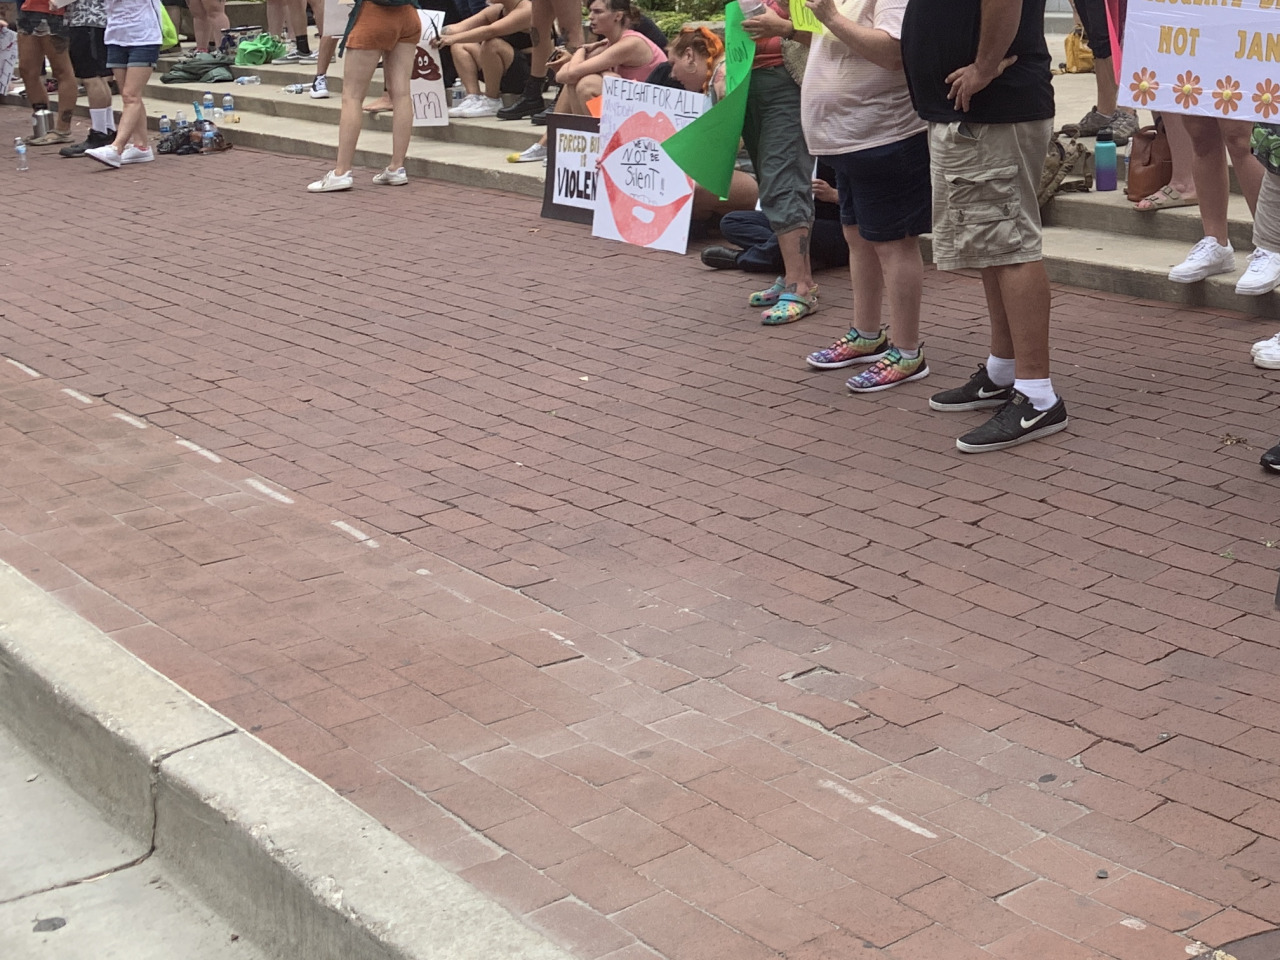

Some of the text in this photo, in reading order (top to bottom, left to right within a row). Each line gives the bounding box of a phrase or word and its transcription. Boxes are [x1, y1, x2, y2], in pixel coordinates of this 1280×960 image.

[1158, 24, 1200, 58] NOT
[604, 80, 699, 115] WE FIGHT FOR ALL
[558, 134, 587, 153] FORCED
[621, 149, 660, 164] NOT BE
[644, 140, 659, 152] WILL
[557, 167, 599, 201] VIOLEN
